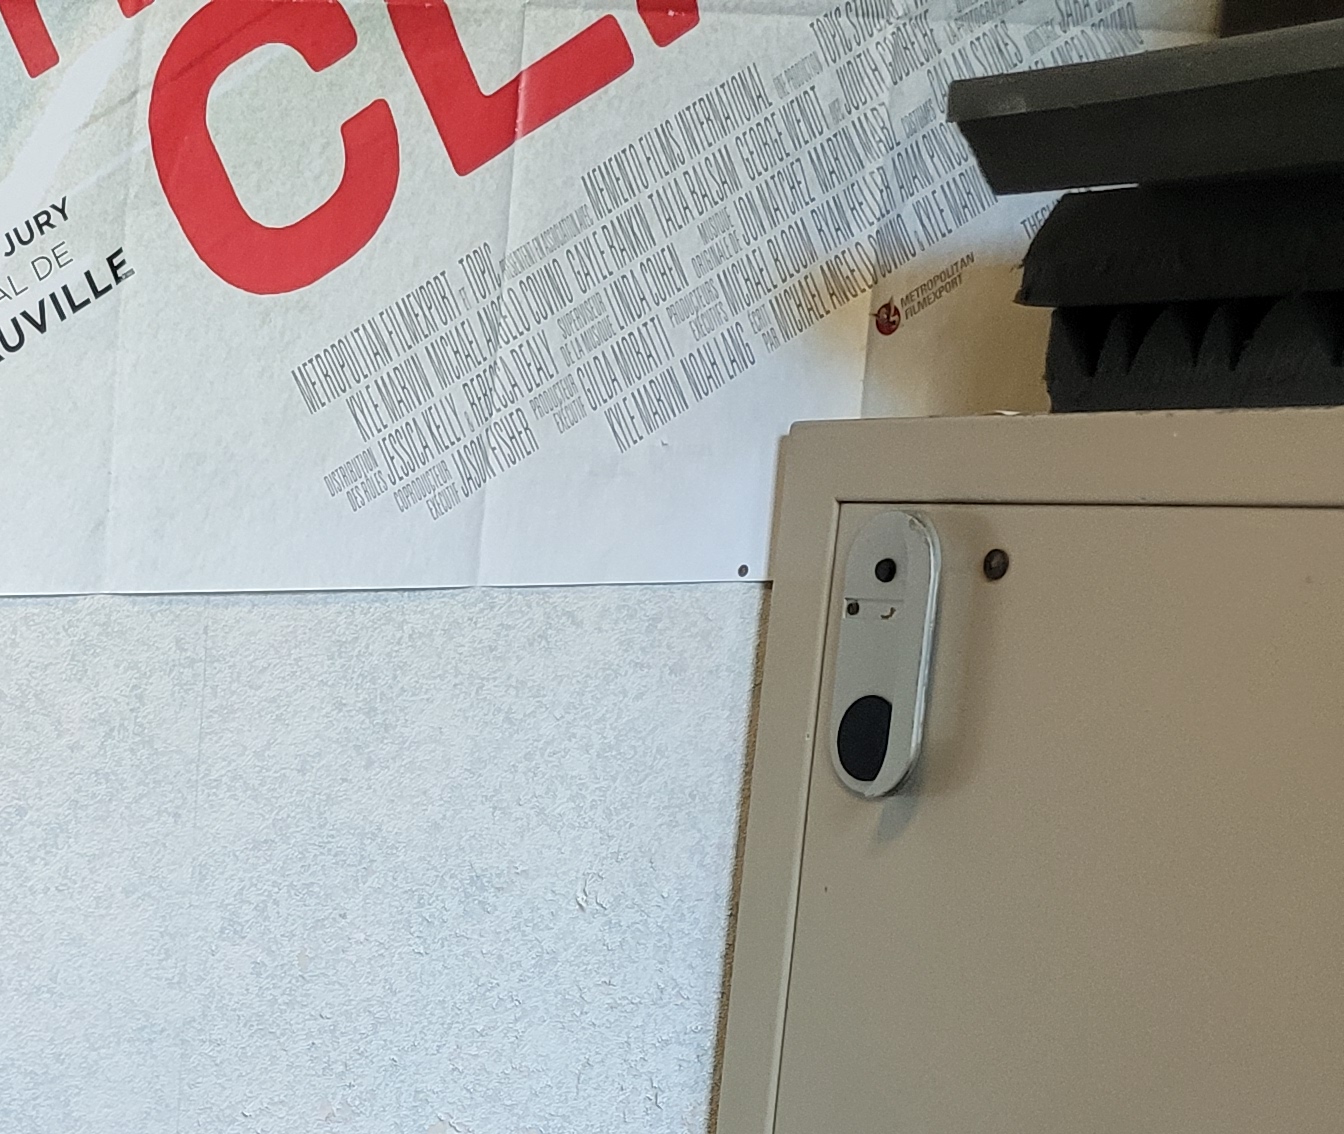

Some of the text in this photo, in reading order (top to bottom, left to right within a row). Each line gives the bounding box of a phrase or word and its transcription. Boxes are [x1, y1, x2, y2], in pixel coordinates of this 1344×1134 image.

[148, 0, 700, 295] CL
[733, 189, 767, 246] JON
[756, 156, 816, 230] NATCHEZ
[807, 124, 867, 195] MARTIN
[850, 100, 902, 164] MABZ
[969, 18, 1025, 75] STOKES
[0, 195, 69, 258] JURY
[290, 316, 393, 415] METROPOLITAN
[377, 269, 462, 357] FILMEXPORT
[457, 240, 504, 304] TOPIC
[580, 142, 649, 221] MEMENTO
[638, 118, 686, 183] FILMS
[673, 62, 773, 159] INTERNATIONAL
[807, 5, 854, 67] TOPIC
[696, 204, 735, 246] MUSIQUE
[716, 245, 779, 317] MICHAEL
[766, 216, 820, 284] BLOOM
[810, 192, 855, 254] RYAN
[841, 163, 898, 233] HELLER
[891, 138, 935, 203] ADAM
[920, 118, 971, 178] PINCU
[29, 240, 73, 282] DE
[345, 383, 389, 443] KYLE
[374, 351, 436, 424] MARVIN
[424, 317, 488, 391] MICHAEL
[476, 285, 531, 357] ANGELO
[518, 256, 575, 325] COVINO
[564, 229, 614, 294] GAYLE
[600, 201, 657, 271] RANKIN
[646, 176, 696, 239] TALIA
[682, 143, 743, 216] BALSAM
[732, 111, 791, 182] GEORGE
[777, 84, 830, 152] WENDT
[835, 46, 890, 115] JUDITH
[690, 228, 744, 280] ORIGINALE DE
[768, 271, 831, 343] MICHAEL
[819, 239, 881, 310] ANGELO
[866, 212, 917, 278] COVINO
[911, 188, 953, 247] KYLE
[603, 241, 690, 331] LINDA COHEN
[665, 277, 720, 328] PRODUCTEURS
[899, 250, 975, 309] METROPOLITAN
[903, 272, 963, 320] FILMEXPORT
[555, 290, 608, 340] SUPERVISEUR
[558, 313, 618, 368] DE LA MUSIQUE
[760, 325, 782, 354] PAR
[575, 313, 675, 412] GILDA MORATTI
[603, 319, 757, 454] KYLE MARVIN NOAH LANG
[376, 416, 436, 485] JESSICA
[420, 391, 466, 455] KELLY
[461, 354, 525, 428] REBECCA
[509, 328, 559, 394] DEALY
[528, 372, 580, 421] PRODUCTEUR
[322, 446, 379, 498] DISTRIBUTION
[450, 405, 540, 498] JASON FISHER
[344, 483, 367, 512] DES
[392, 458, 454, 513] COPRODUCTEUR
